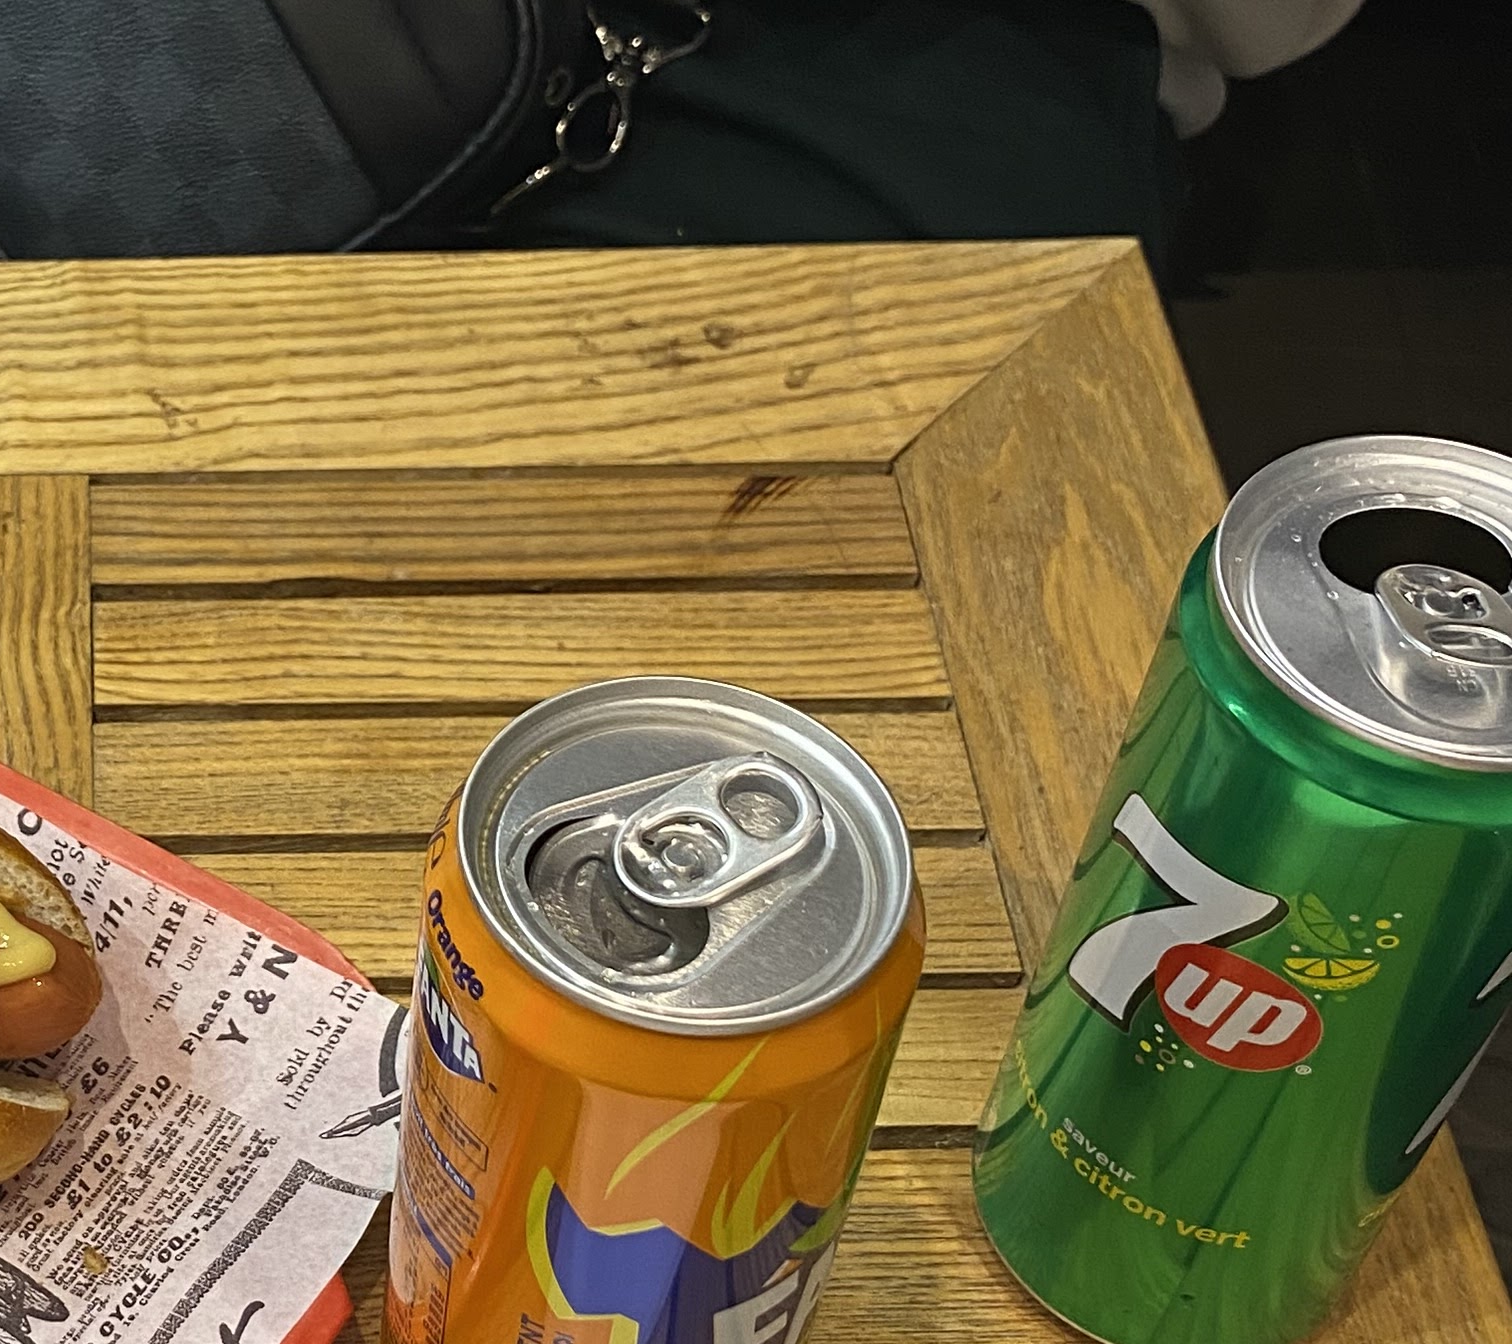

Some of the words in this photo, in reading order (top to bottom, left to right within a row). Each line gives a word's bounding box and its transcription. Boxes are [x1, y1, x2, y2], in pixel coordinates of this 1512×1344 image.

[85, 896, 133, 953] 4/11,
[428, 889, 484, 1001] Orange
[1068, 792, 1289, 1032] 7
[175, 935, 207, 972] best
[178, 989, 231, 1056] Please
[215, 1017, 249, 1044] Y
[243, 988, 276, 1015] &
[261, 943, 298, 980] N
[1162, 962, 1309, 1052] up
[79, 1056, 110, 1095] £6
[275, 1047, 310, 1087] Sold
[305, 1015, 330, 1037] by
[283, 1015, 352, 1110] throughout
[17, 1211, 45, 1240] 200
[43, 1129, 110, 1208] SECOND-HAND
[108, 1083, 146, 1126] CYCLES
[65, 1177, 91, 1210] £1
[92, 1152, 113, 1174] to
[1061, 1116, 1136, 1183] saveur
[1050, 1128, 1068, 1159] &
[1074, 1157, 1167, 1227] citron
[1176, 1218, 1251, 1249] vert
[98, 1267, 156, 1337] CYCLE
